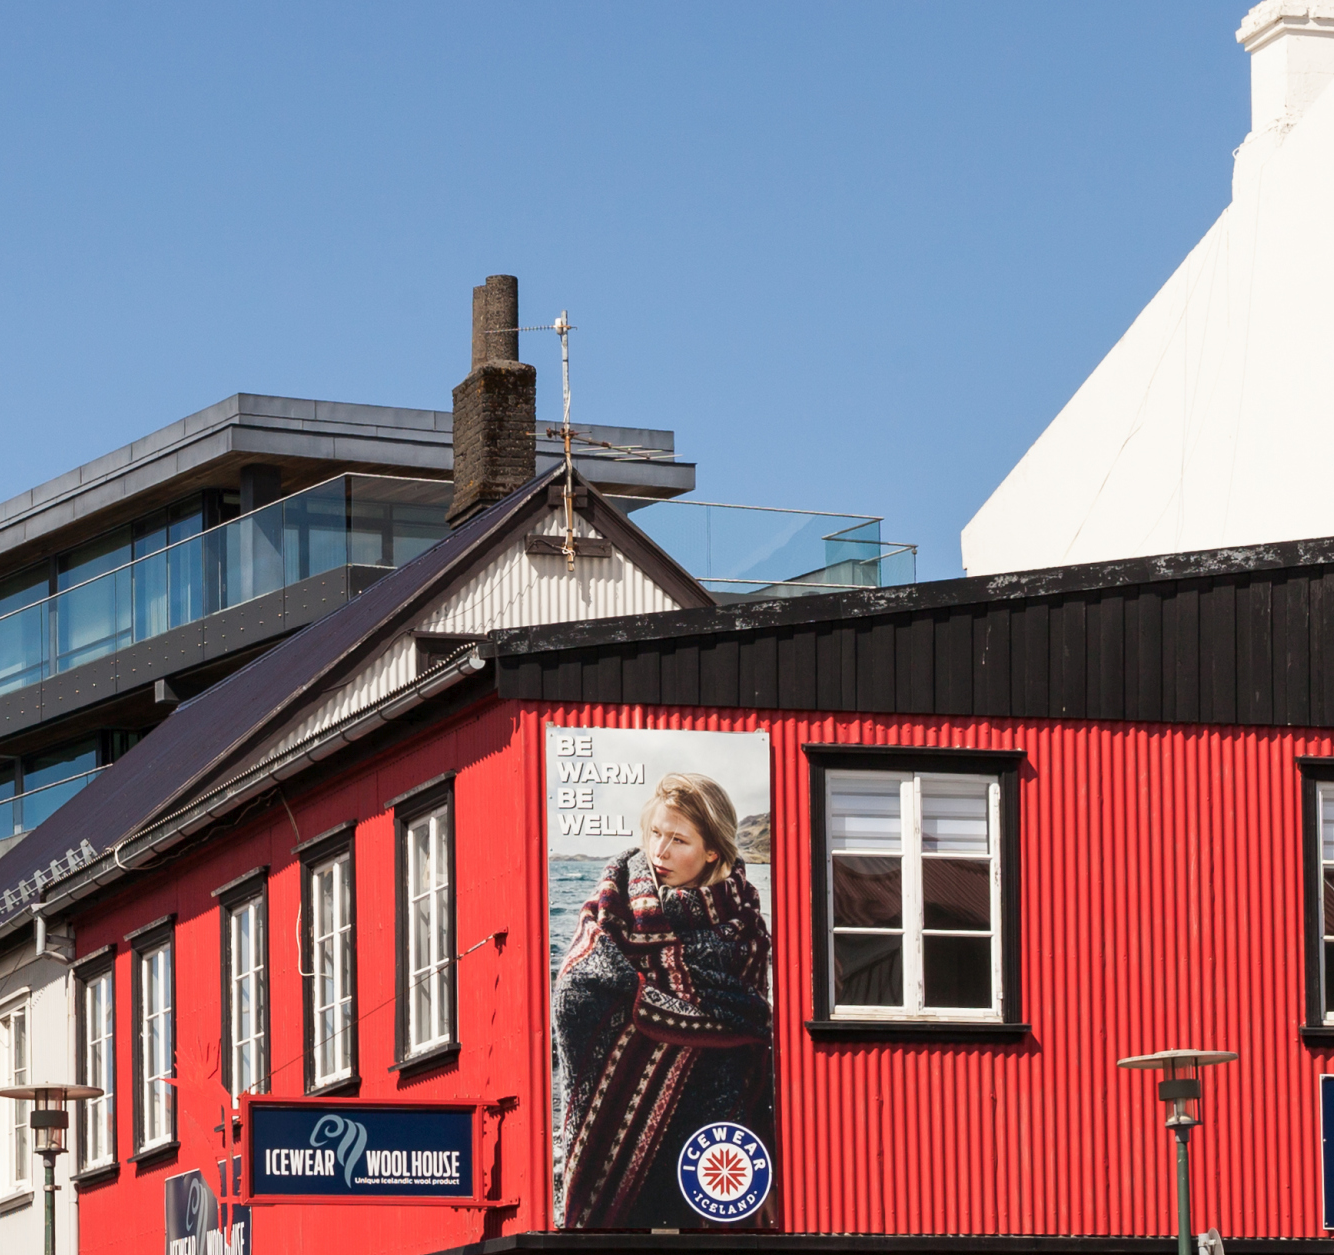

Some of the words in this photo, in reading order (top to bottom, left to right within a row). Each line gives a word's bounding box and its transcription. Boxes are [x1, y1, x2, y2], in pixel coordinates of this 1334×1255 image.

[556, 735, 593, 757] BE
[556, 762, 645, 785] WARM
[557, 787, 594, 810] BE
[557, 813, 633, 837] WELL
[683, 1127, 766, 1171] ICEWEAR
[265, 1149, 335, 1176] ICEWEAR
[354, 1177, 380, 1185] Unique
[381, 1177, 413, 1185] Icelandic
[432, 1178, 460, 1186] product
[694, 1193, 756, 1215] ICELAND
